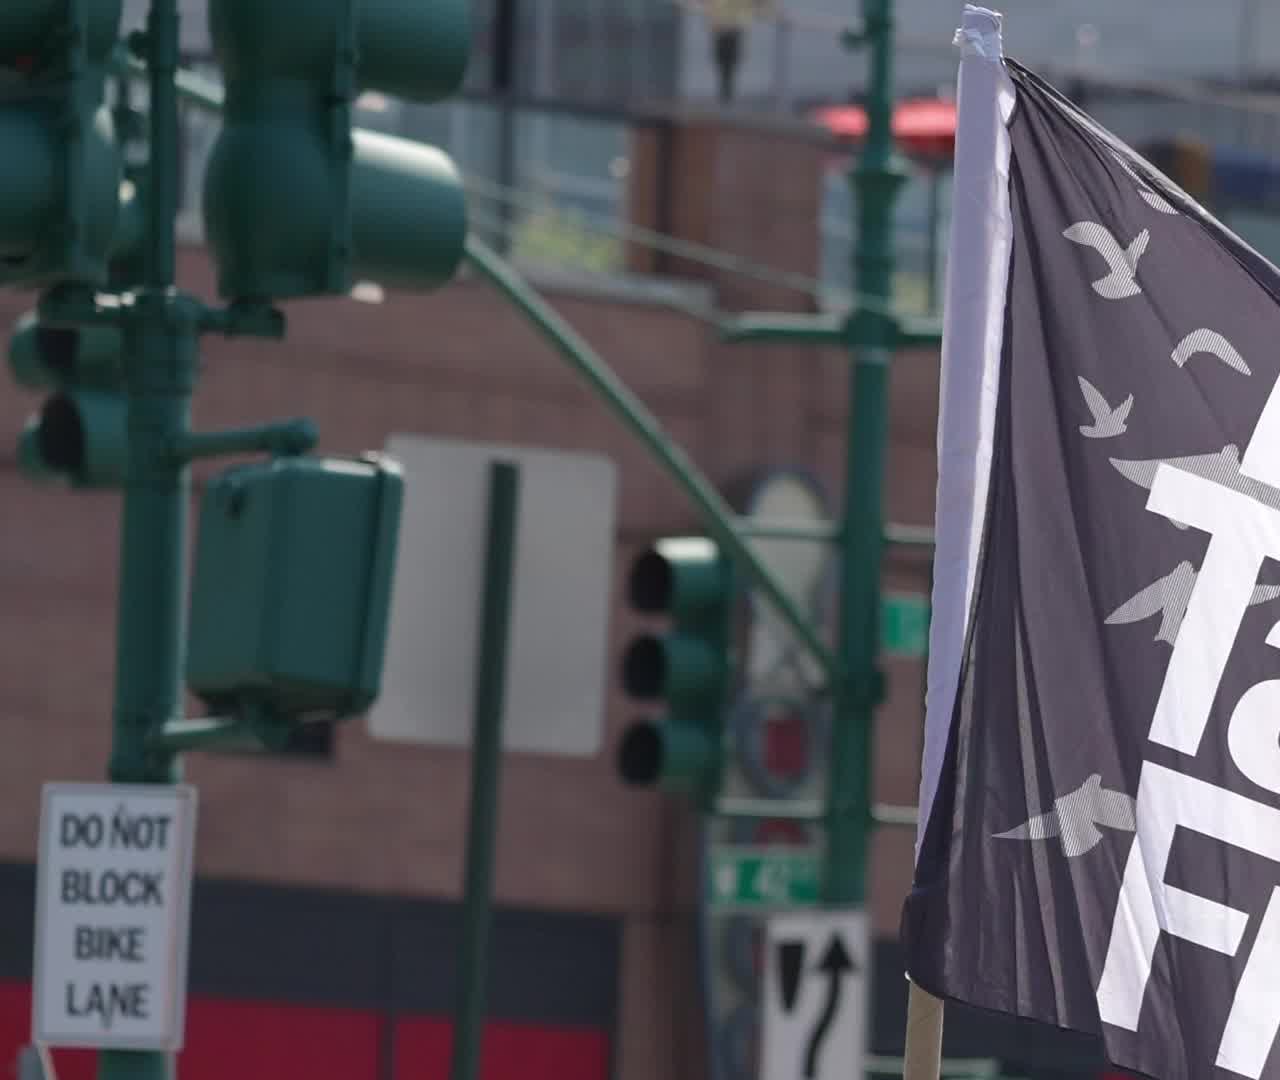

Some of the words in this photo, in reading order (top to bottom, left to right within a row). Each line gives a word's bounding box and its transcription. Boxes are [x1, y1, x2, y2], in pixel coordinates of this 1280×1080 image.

[59, 812, 101, 849] DO
[111, 810, 171, 850] NOT
[60, 868, 165, 906] BLOCK
[74, 924, 145, 963] BIKE
[65, 981, 153, 1019] LANE
